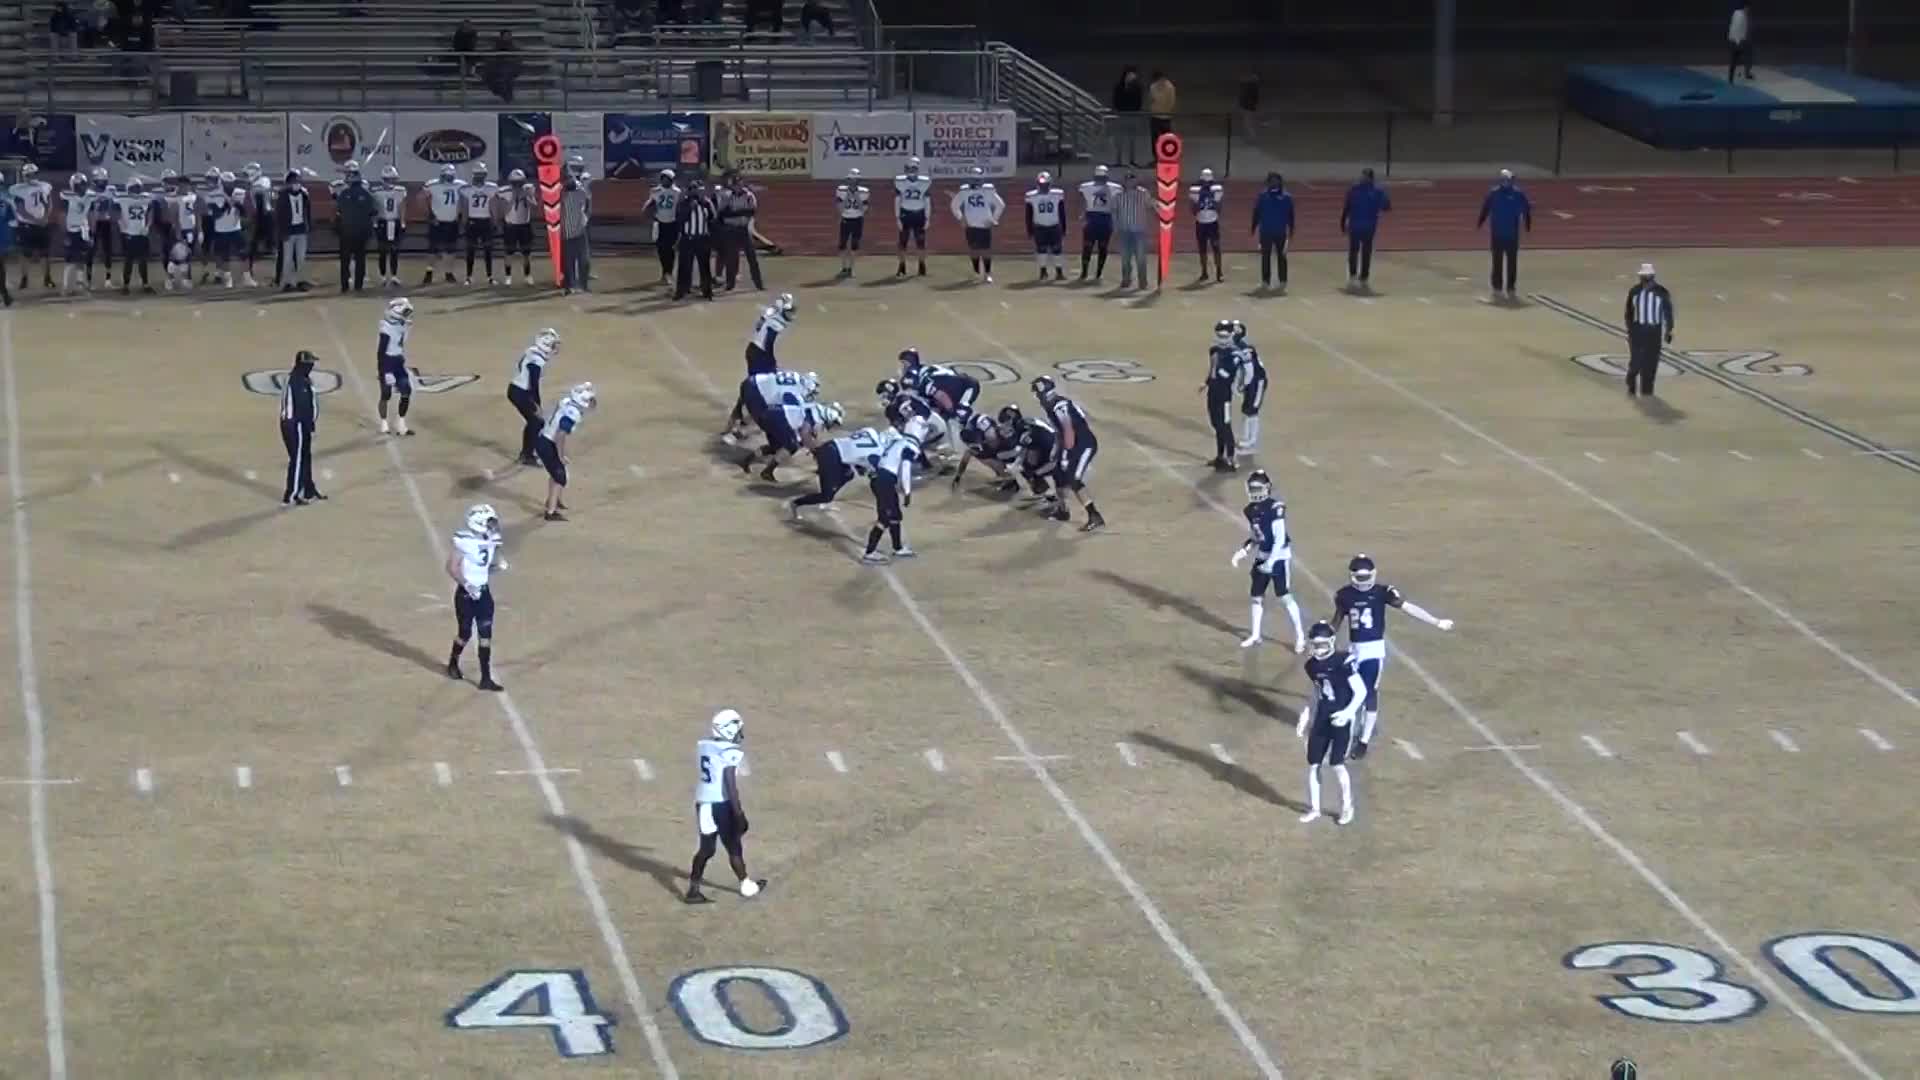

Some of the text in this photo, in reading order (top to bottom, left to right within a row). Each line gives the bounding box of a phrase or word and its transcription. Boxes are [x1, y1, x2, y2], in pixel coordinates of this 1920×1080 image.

[925, 113, 1004, 125] FACTORY
[933, 127, 993, 138] DIRECT
[834, 135, 911, 151] PATRIOT
[477, 549, 489, 567] 3
[1349, 607, 1373, 629] 24
[700, 755, 712, 784] 5
[444, 965, 850, 1058] 40
